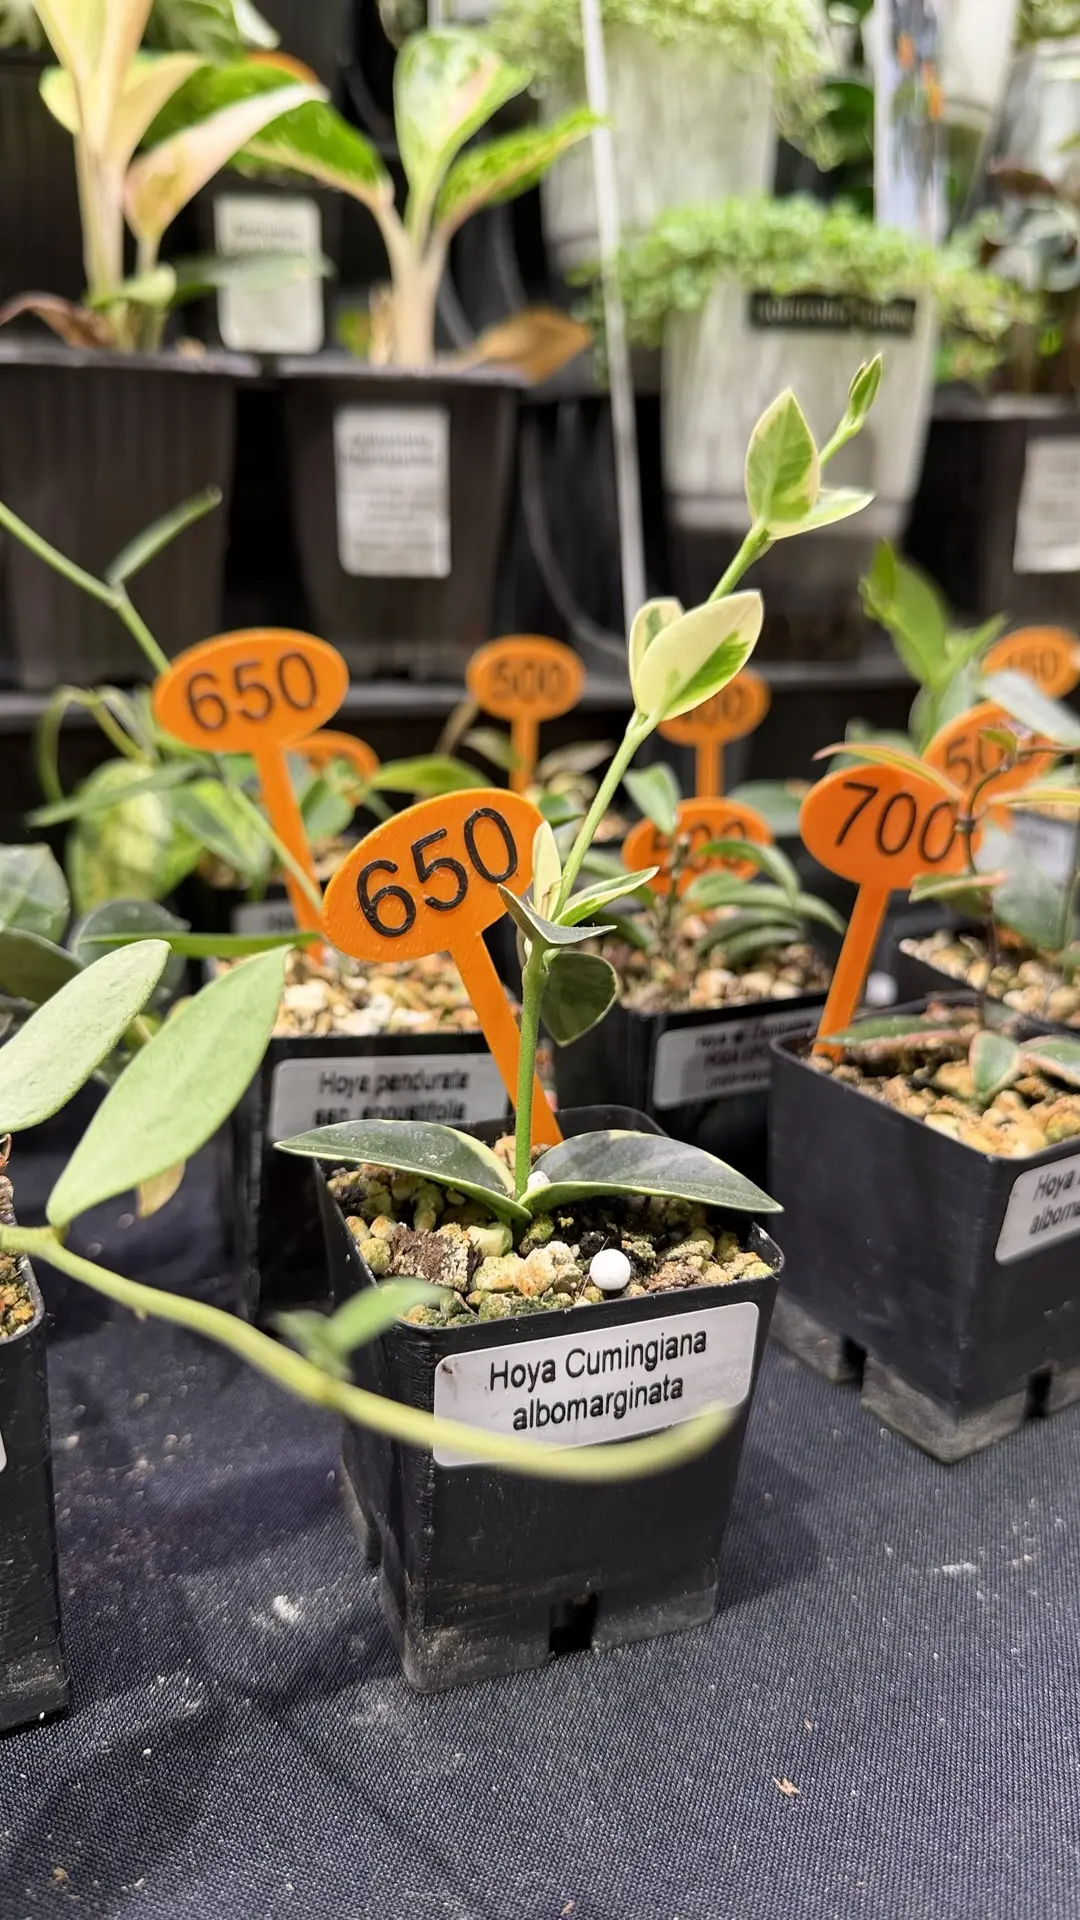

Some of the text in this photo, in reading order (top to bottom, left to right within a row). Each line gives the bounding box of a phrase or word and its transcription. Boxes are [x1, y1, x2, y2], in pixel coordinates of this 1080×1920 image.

[186, 652, 319, 732] 650
[945, 725, 1036, 787] 50
[835, 780, 960, 864] 700
[357, 807, 518, 938] 650
[319, 1072, 369, 1098] Hoya
[1033, 1170, 1075, 1202] Hoya
[489, 1330, 707, 1393] Hoya Cumingiana
[512, 1374, 684, 1430] albomarginata
